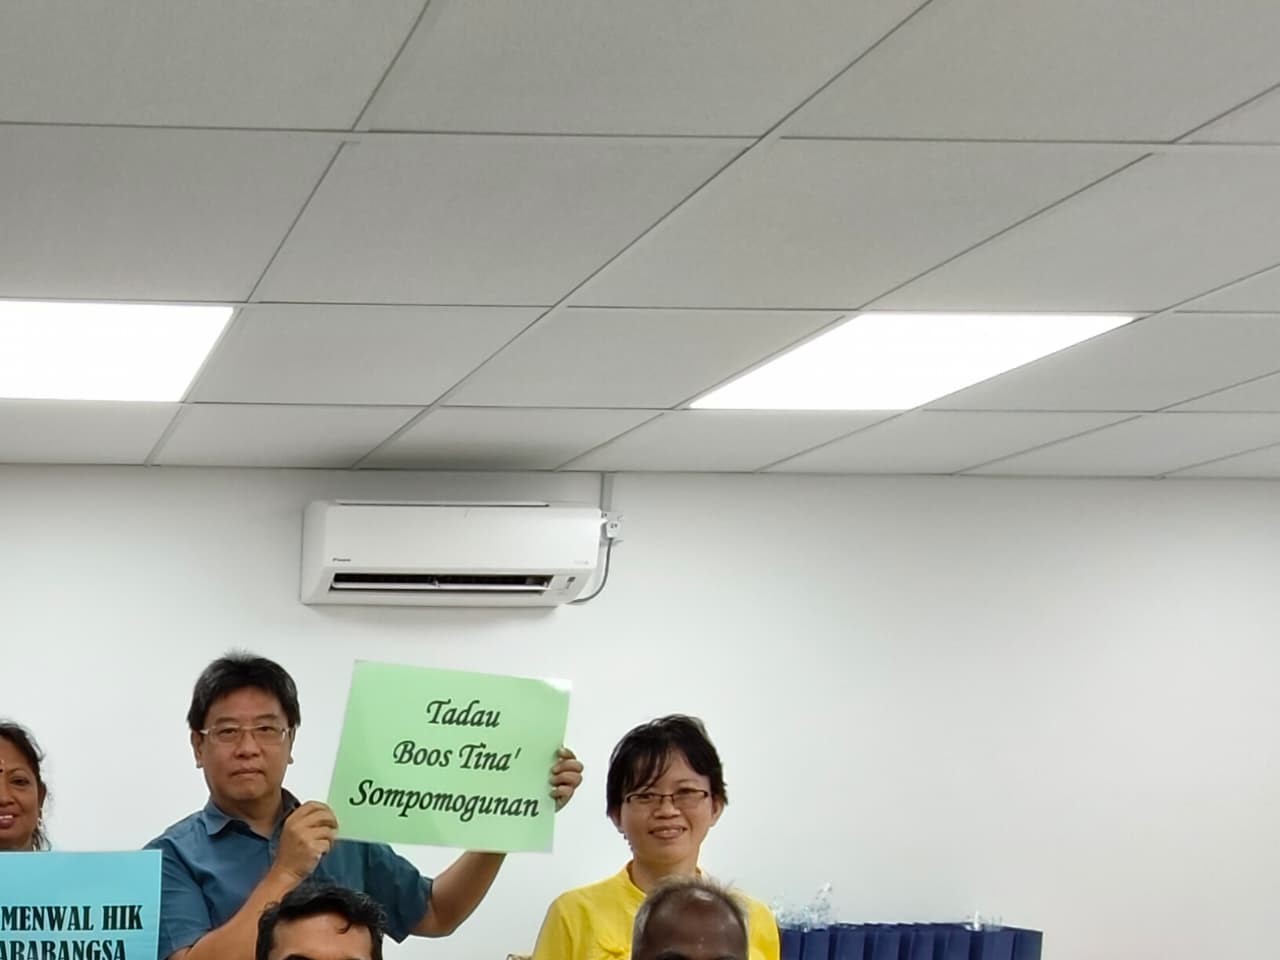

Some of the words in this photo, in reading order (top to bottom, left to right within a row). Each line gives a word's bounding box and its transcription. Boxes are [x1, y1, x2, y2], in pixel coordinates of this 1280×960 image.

[426, 698, 501, 729] Tadau
[392, 740, 454, 768] Boos
[348, 779, 540, 823] Sompomogunan
[0, 905, 95, 932] MENWAL
[101, 904, 144, 931] HIK
